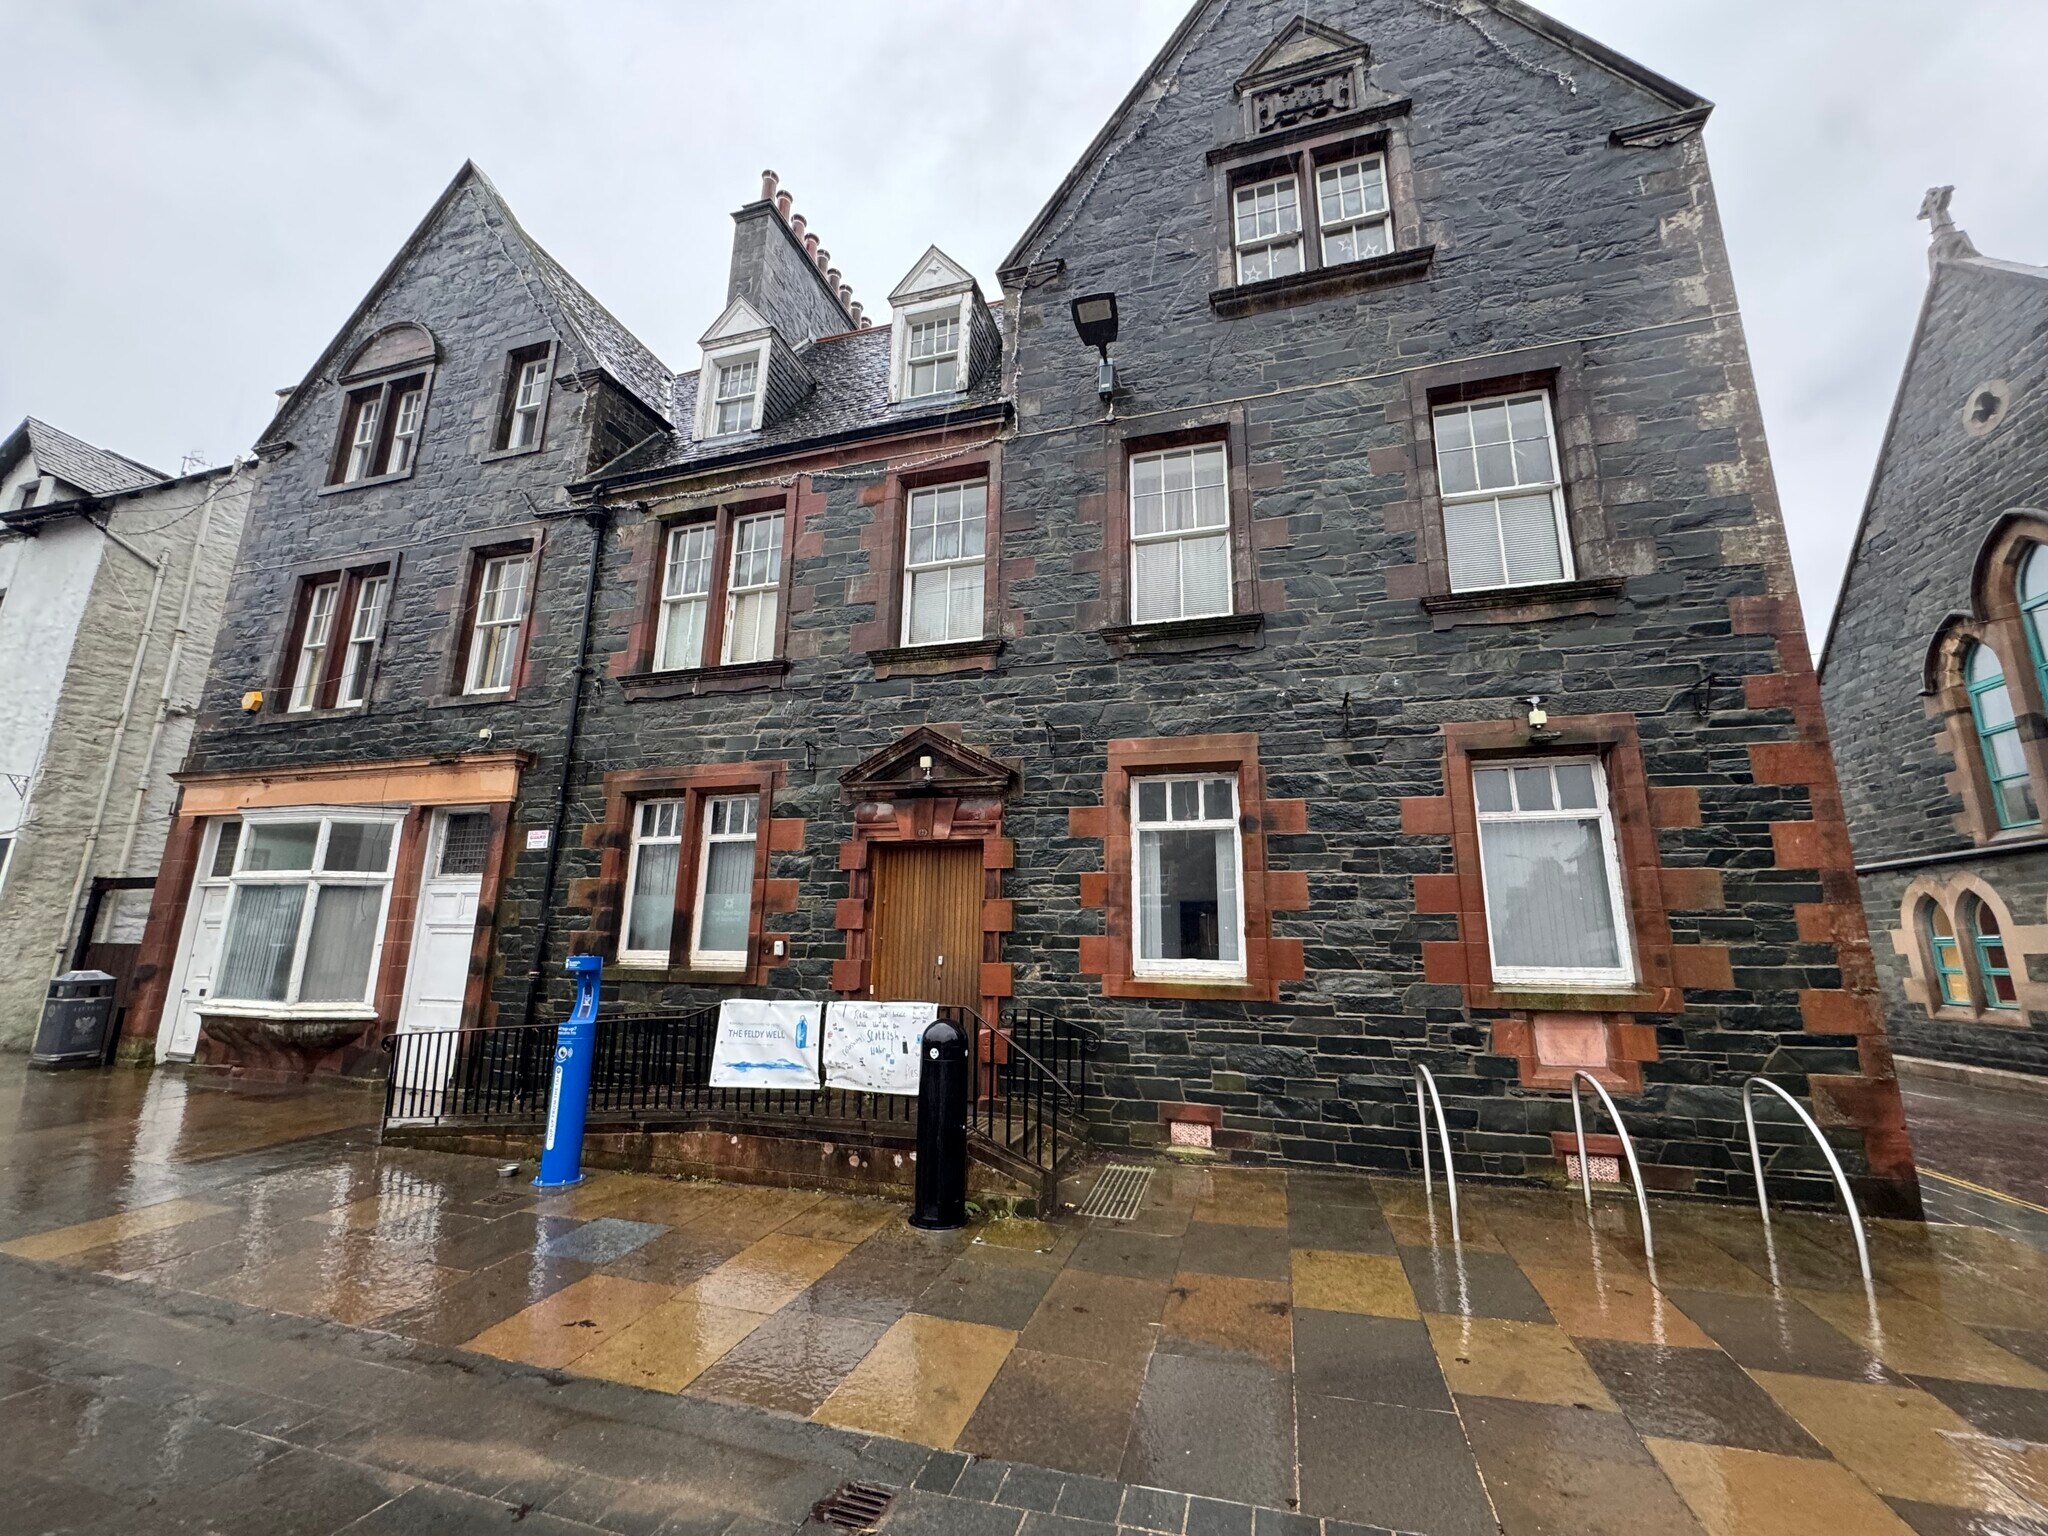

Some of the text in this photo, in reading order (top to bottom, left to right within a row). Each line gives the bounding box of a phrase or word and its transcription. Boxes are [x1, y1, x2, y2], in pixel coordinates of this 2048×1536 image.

[728, 1029, 785, 1039] THE FELDY WELL
[866, 1029, 899, 1043] Scottish
